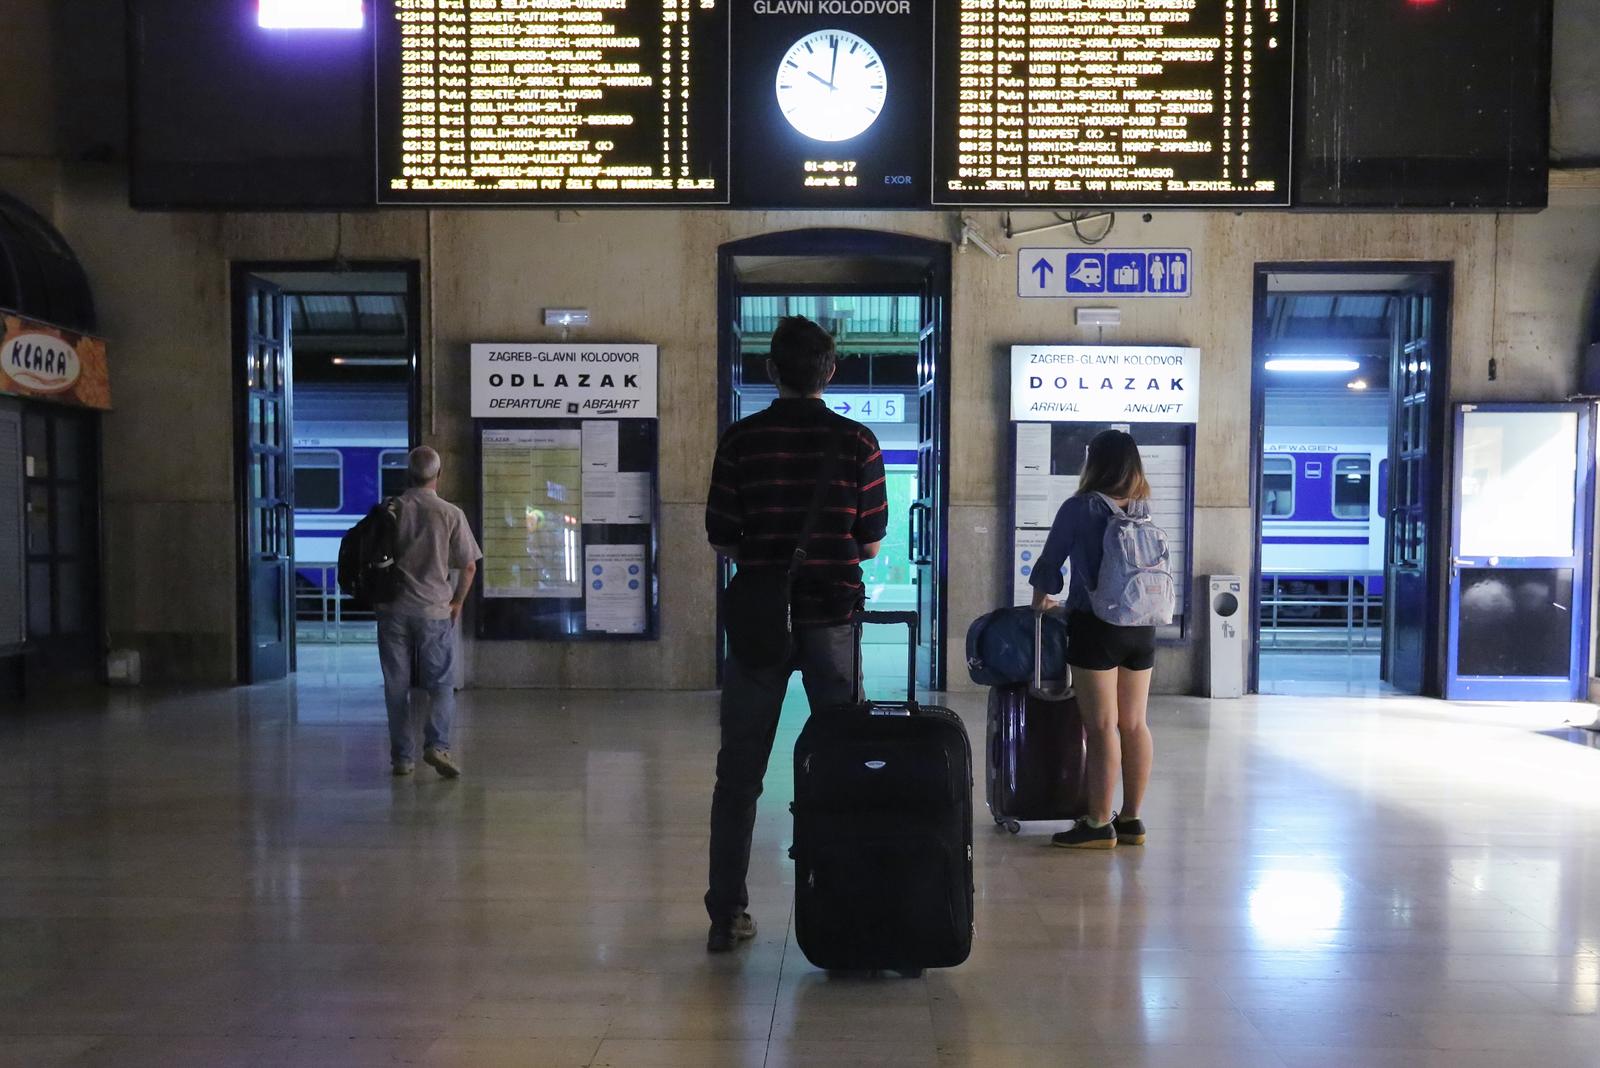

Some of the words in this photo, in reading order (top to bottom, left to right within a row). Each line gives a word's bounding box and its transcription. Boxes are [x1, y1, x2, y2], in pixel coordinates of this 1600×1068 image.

[753, 0, 813, 14] GLAVNI
[818, 0, 911, 14] KOLODVOR
[999, 0, 1025, 9] Putn
[1265, 0, 1277, 9] 11
[439, 12, 465, 22] Putn
[961, 12, 994, 22] 22:12
[998, 12, 1025, 22] Putn
[1246, 12, 1251, 22] 1
[439, 25, 465, 34] Putn
[961, 25, 994, 35] 22:14
[998, 25, 1025, 35] Putn
[1225, 25, 1233, 35] 3
[402, 38, 434, 47] 22:34
[439, 38, 466, 47] Putn
[663, 38, 670, 47] 2
[681, 38, 689, 47] 3
[998, 38, 1025, 48] Putn
[1225, 38, 1233, 48] 3
[439, 51, 466, 60] Putn
[663, 51, 670, 60] 4
[682, 51, 689, 60] 2
[998, 51, 1025, 61] Putn
[1225, 51, 1232, 61] 3
[439, 63, 466, 73] Putn
[682, 63, 688, 73] 1
[998, 64, 1012, 74] EC
[1225, 64, 1232, 74] 2
[439, 76, 466, 86] Putn
[663, 76, 670, 86] 4
[681, 76, 689, 86] 2
[960, 77, 993, 87] 23:13
[998, 77, 1024, 87] Putn
[1225, 77, 1230, 87] 1
[1244, 77, 1249, 87] 1
[439, 89, 466, 99] Putn
[663, 89, 670, 99] 3
[681, 89, 689, 99] 4
[960, 89, 993, 100] 23:17
[997, 89, 1024, 100] Putn
[1224, 89, 1231, 100] 3
[1243, 89, 1250, 100] 4
[664, 102, 669, 112] 1
[682, 102, 688, 112] 1
[1225, 102, 1230, 113] 1
[1244, 102, 1249, 113] 1
[664, 115, 669, 125] 1
[682, 115, 688, 125] 1
[997, 115, 1024, 126] Putn
[1223, 115, 1231, 126] 2
[1242, 115, 1250, 126] 2
[664, 128, 669, 138] 1
[682, 128, 688, 138] 1
[1224, 128, 1229, 138] 1
[1243, 128, 1248, 138] 1
[664, 141, 669, 151] 1
[682, 141, 688, 151] 1
[997, 141, 1023, 151] Putn
[1223, 141, 1230, 151] 3
[1242, 141, 1249, 151] 4
[664, 154, 669, 163] 1
[682, 154, 688, 163] 1
[1224, 154, 1228, 164] 1
[1243, 154, 1247, 164] 1
[440, 166, 467, 176] Putn
[663, 166, 670, 176] 2
[1223, 167, 1228, 177] 1
[1242, 167, 1247, 177] 1
[884, 175, 912, 185] EXOR
[11, 341, 67, 376] KLARA
[488, 351, 576, 362] ZAGREB-GLAVNI
[581, 352, 639, 362] KOLODVOR
[1030, 353, 1119, 365] ZAGREB-GLAVNI
[1124, 354, 1183, 366] KOLODVOR
[489, 373, 638, 388] ODLAZAK
[1030, 376, 1184, 391] DOLAZAK
[489, 398, 562, 409] DEPARTURE
[582, 399, 640, 409] ABFAHRT
[861, 400, 872, 416] 4
[885, 400, 896, 416] 5
[1030, 402, 1080, 412] ARRIVAL
[1124, 403, 1184, 414] ANKUNFT
